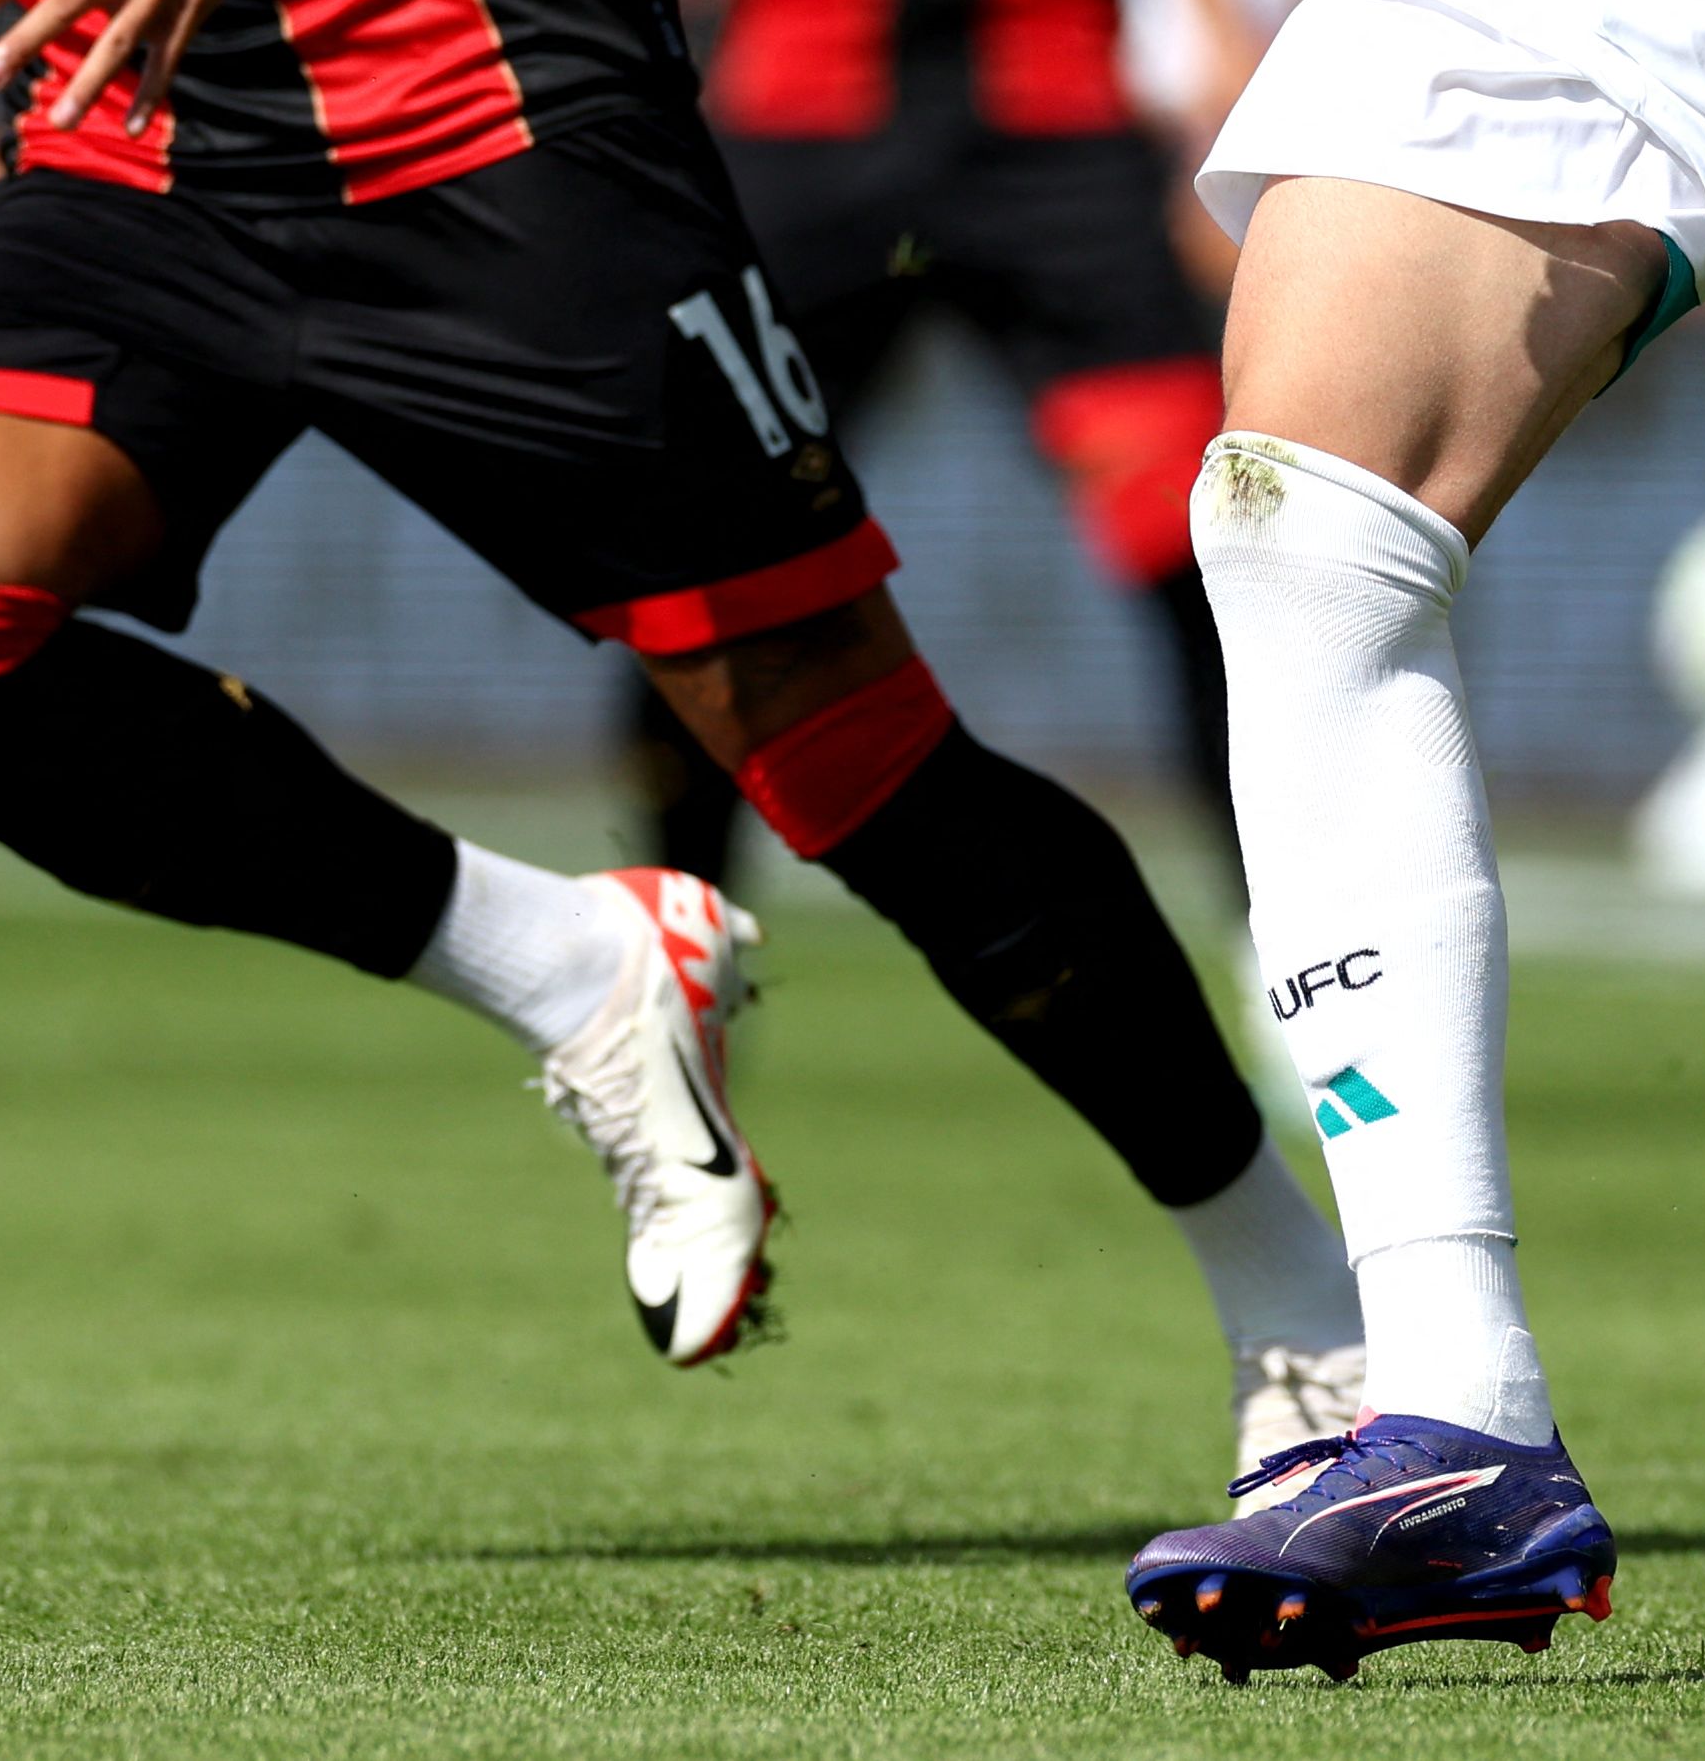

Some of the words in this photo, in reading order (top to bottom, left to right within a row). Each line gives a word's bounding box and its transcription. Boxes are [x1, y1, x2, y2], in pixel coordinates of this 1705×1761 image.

[667, 264, 829, 459] 16
[1267, 947, 1383, 1024] UFC
[1398, 1497, 1467, 1531] LIVRAMENTO
